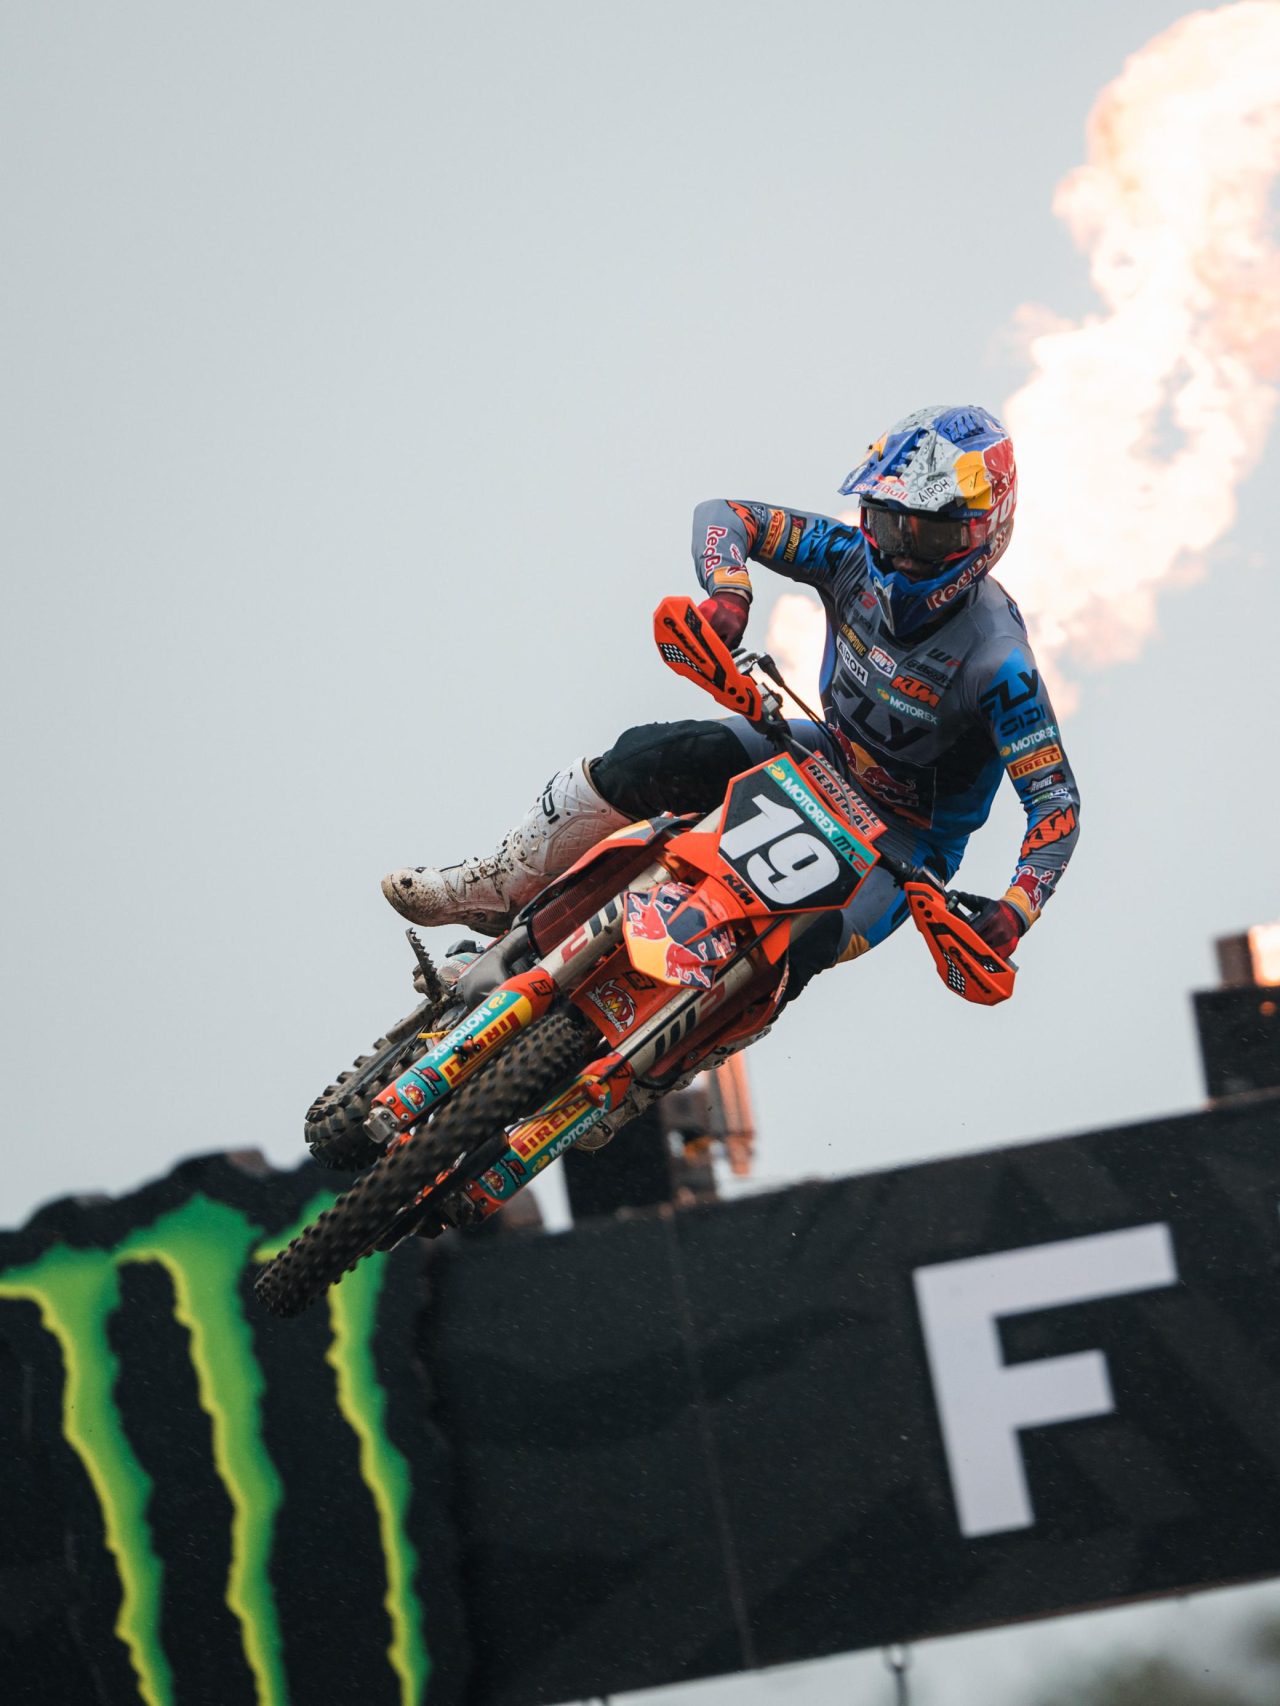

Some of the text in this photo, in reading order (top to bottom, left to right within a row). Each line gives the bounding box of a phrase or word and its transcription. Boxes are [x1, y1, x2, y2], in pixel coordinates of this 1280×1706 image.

[918, 479, 951, 502] AIROH
[926, 568, 972, 611] Red
[838, 640, 867, 683] AIROH
[871, 649, 896, 674] 100%
[889, 695, 939, 726] MOTOREX
[890, 675, 941, 709] KTM
[979, 668, 1039, 720] FLY
[1000, 703, 1047, 738] SIDI
[1011, 725, 1057, 753] MOTOREX
[1009, 746, 1062, 780] PIRELLI
[807, 763, 871, 837] RENTHAL
[781, 777, 869, 872] MOTOREX MX2
[1020, 807, 1076, 860] KTM
[719, 793, 840, 905] 19
[721, 873, 755, 906] KTM
[428, 1005, 493, 1061] MOTOREX
[510, 1083, 589, 1158] PIRELL
[548, 1104, 609, 1159] MOTOREX
